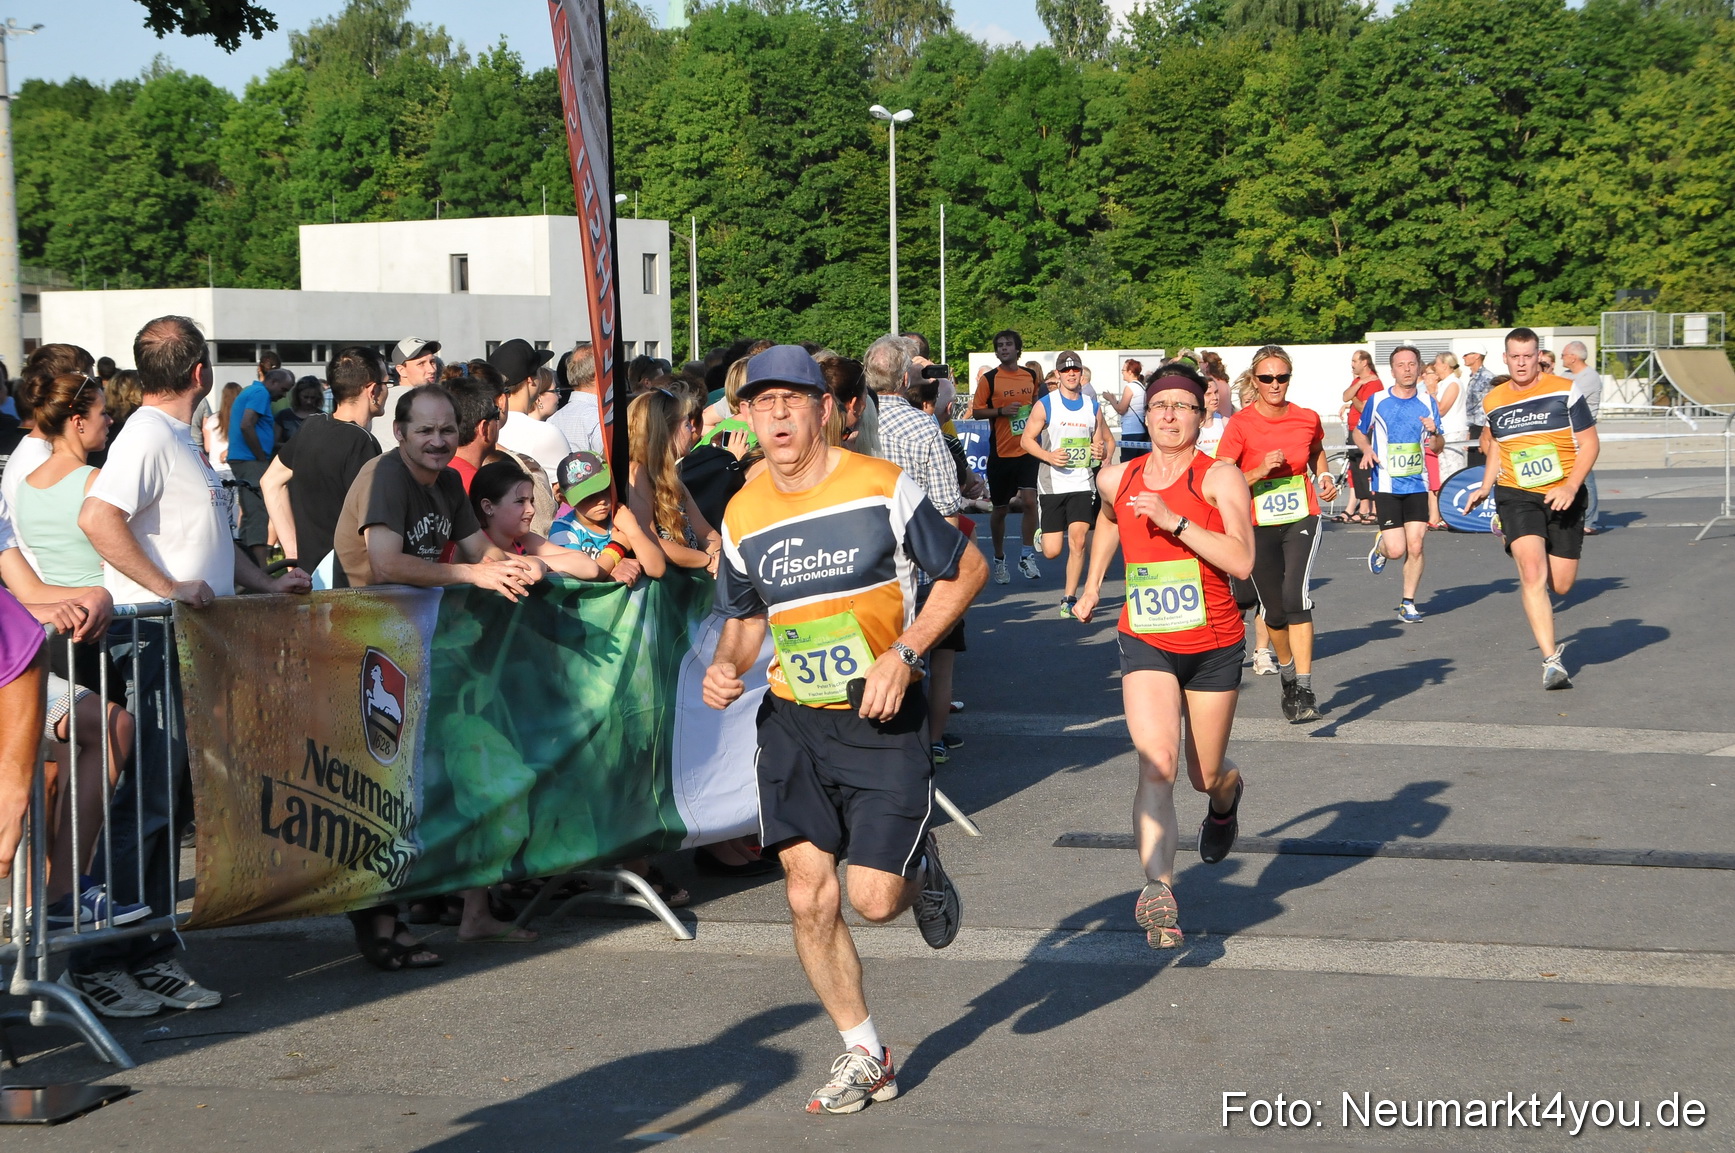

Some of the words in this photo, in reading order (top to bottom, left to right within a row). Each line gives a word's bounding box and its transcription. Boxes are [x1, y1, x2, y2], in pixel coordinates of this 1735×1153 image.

[1012, 417, 1029, 431] 50
[1504, 411, 1551, 426] Fischer
[1508, 419, 1548, 429] AUTOMOBILE
[1065, 448, 1086, 460] 523
[1390, 453, 1422, 468] 1042
[1521, 457, 1553, 477] 400
[1262, 492, 1299, 513] 495
[771, 546, 860, 578] Fischer
[780, 565, 854, 587] AUTOMOBILE
[1129, 584, 1199, 615] 1309
[790, 645, 858, 684] 378
[372, 731, 391, 755] 1628
[261, 774, 413, 887] Lammsb
